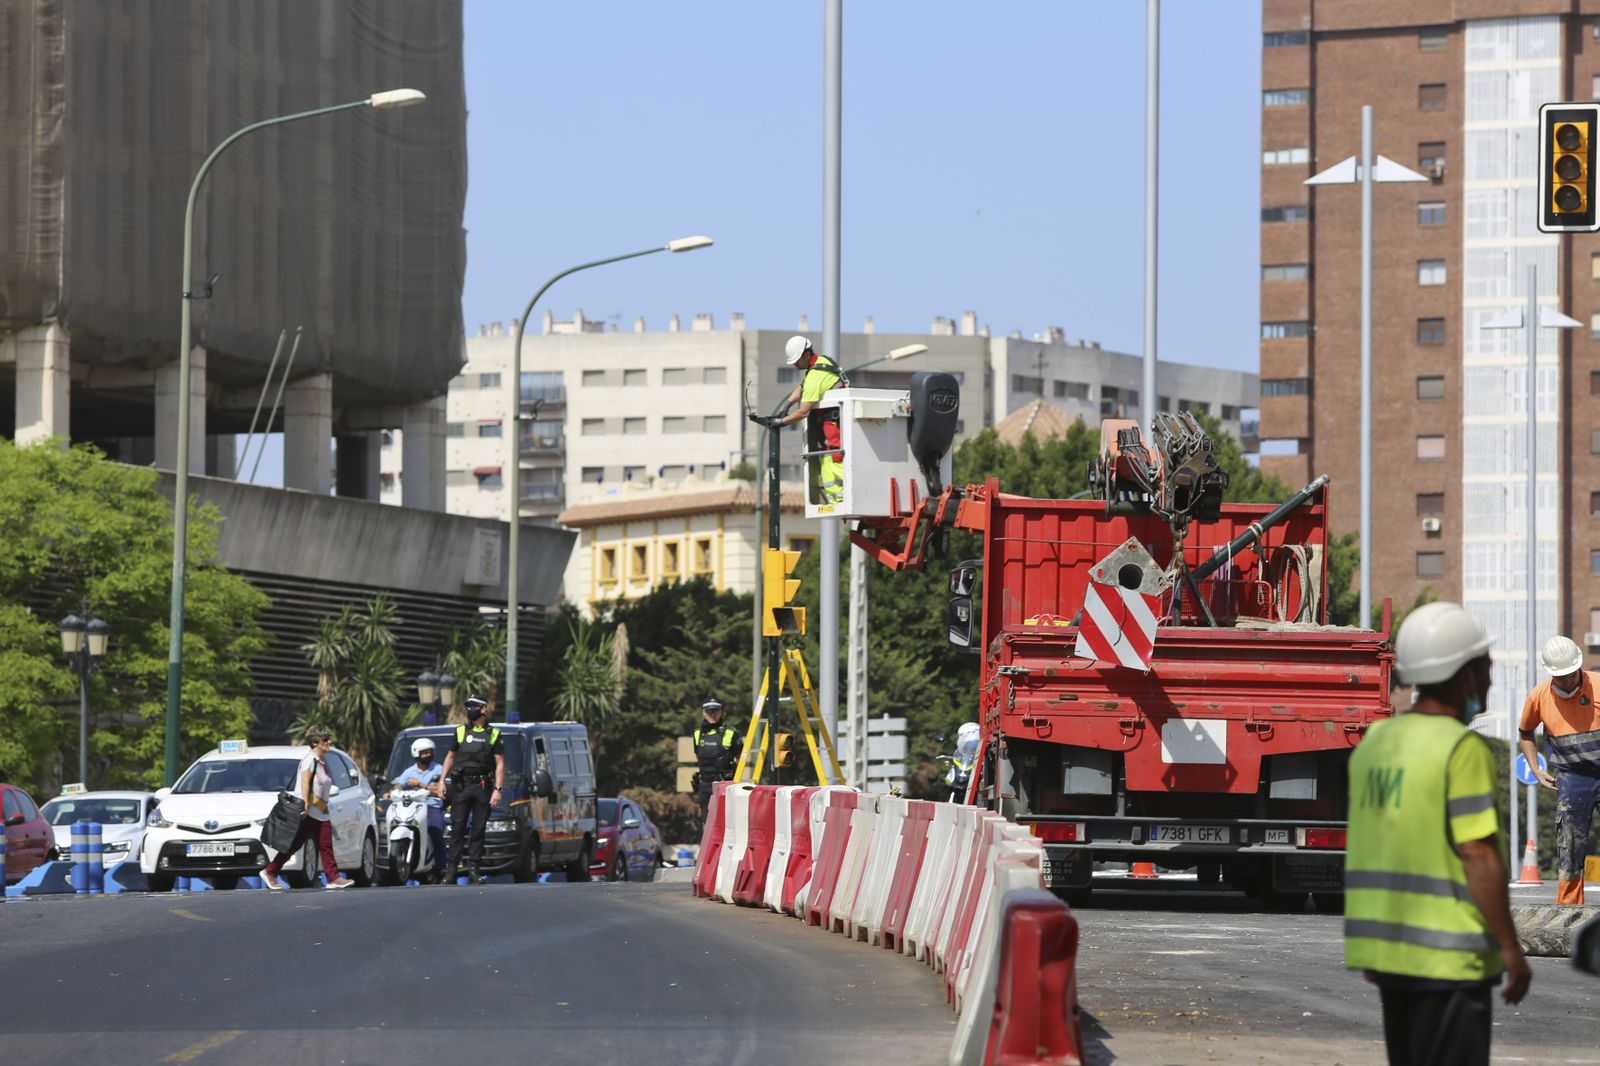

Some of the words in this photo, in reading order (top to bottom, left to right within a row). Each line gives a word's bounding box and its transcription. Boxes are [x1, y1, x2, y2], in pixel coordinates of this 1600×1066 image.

[1161, 827, 1192, 841] 7381
[1198, 827, 1223, 841] GFK
[1267, 831, 1286, 840] MP
